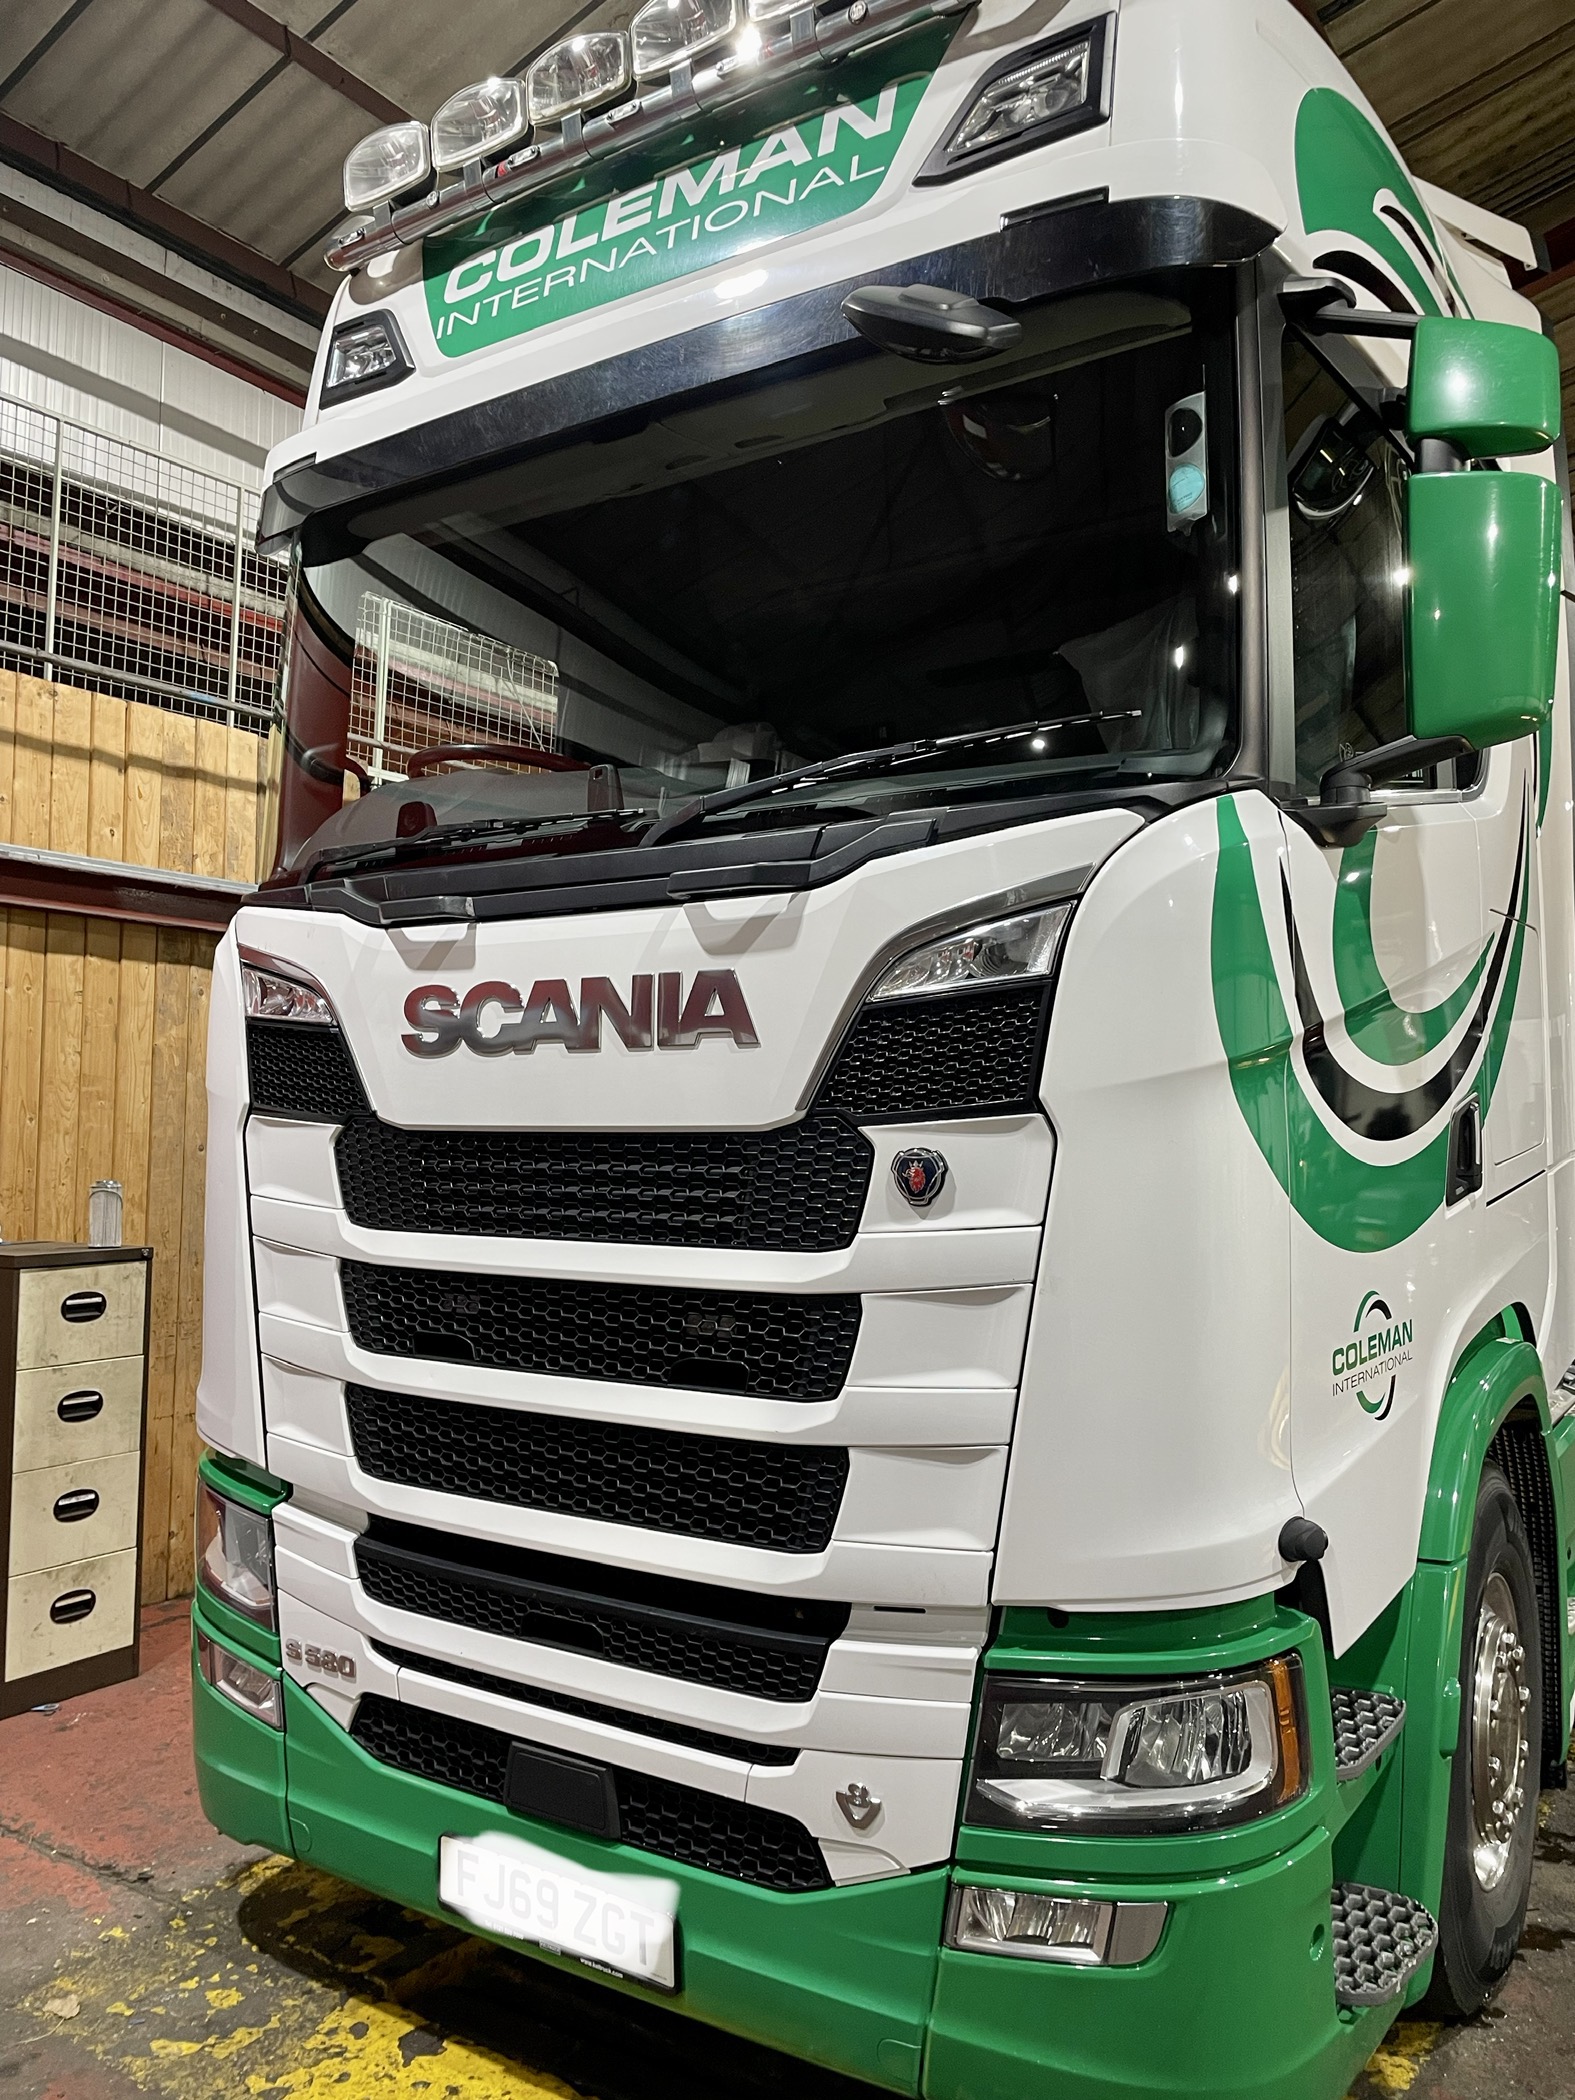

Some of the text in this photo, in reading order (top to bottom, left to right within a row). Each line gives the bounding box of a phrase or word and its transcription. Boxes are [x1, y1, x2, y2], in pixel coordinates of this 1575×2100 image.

[443, 86, 899, 305] COLEMAN
[436, 154, 887, 339] INTERNATIONAL
[401, 969, 761, 1059] SCANIA
[1332, 1319, 1413, 1376] COLEMAN
[1332, 1350, 1413, 1397] INTERNATIONAL
[286, 1638, 357, 1679] S 580
[457, 1849, 655, 1966] FJ69 ZGT
